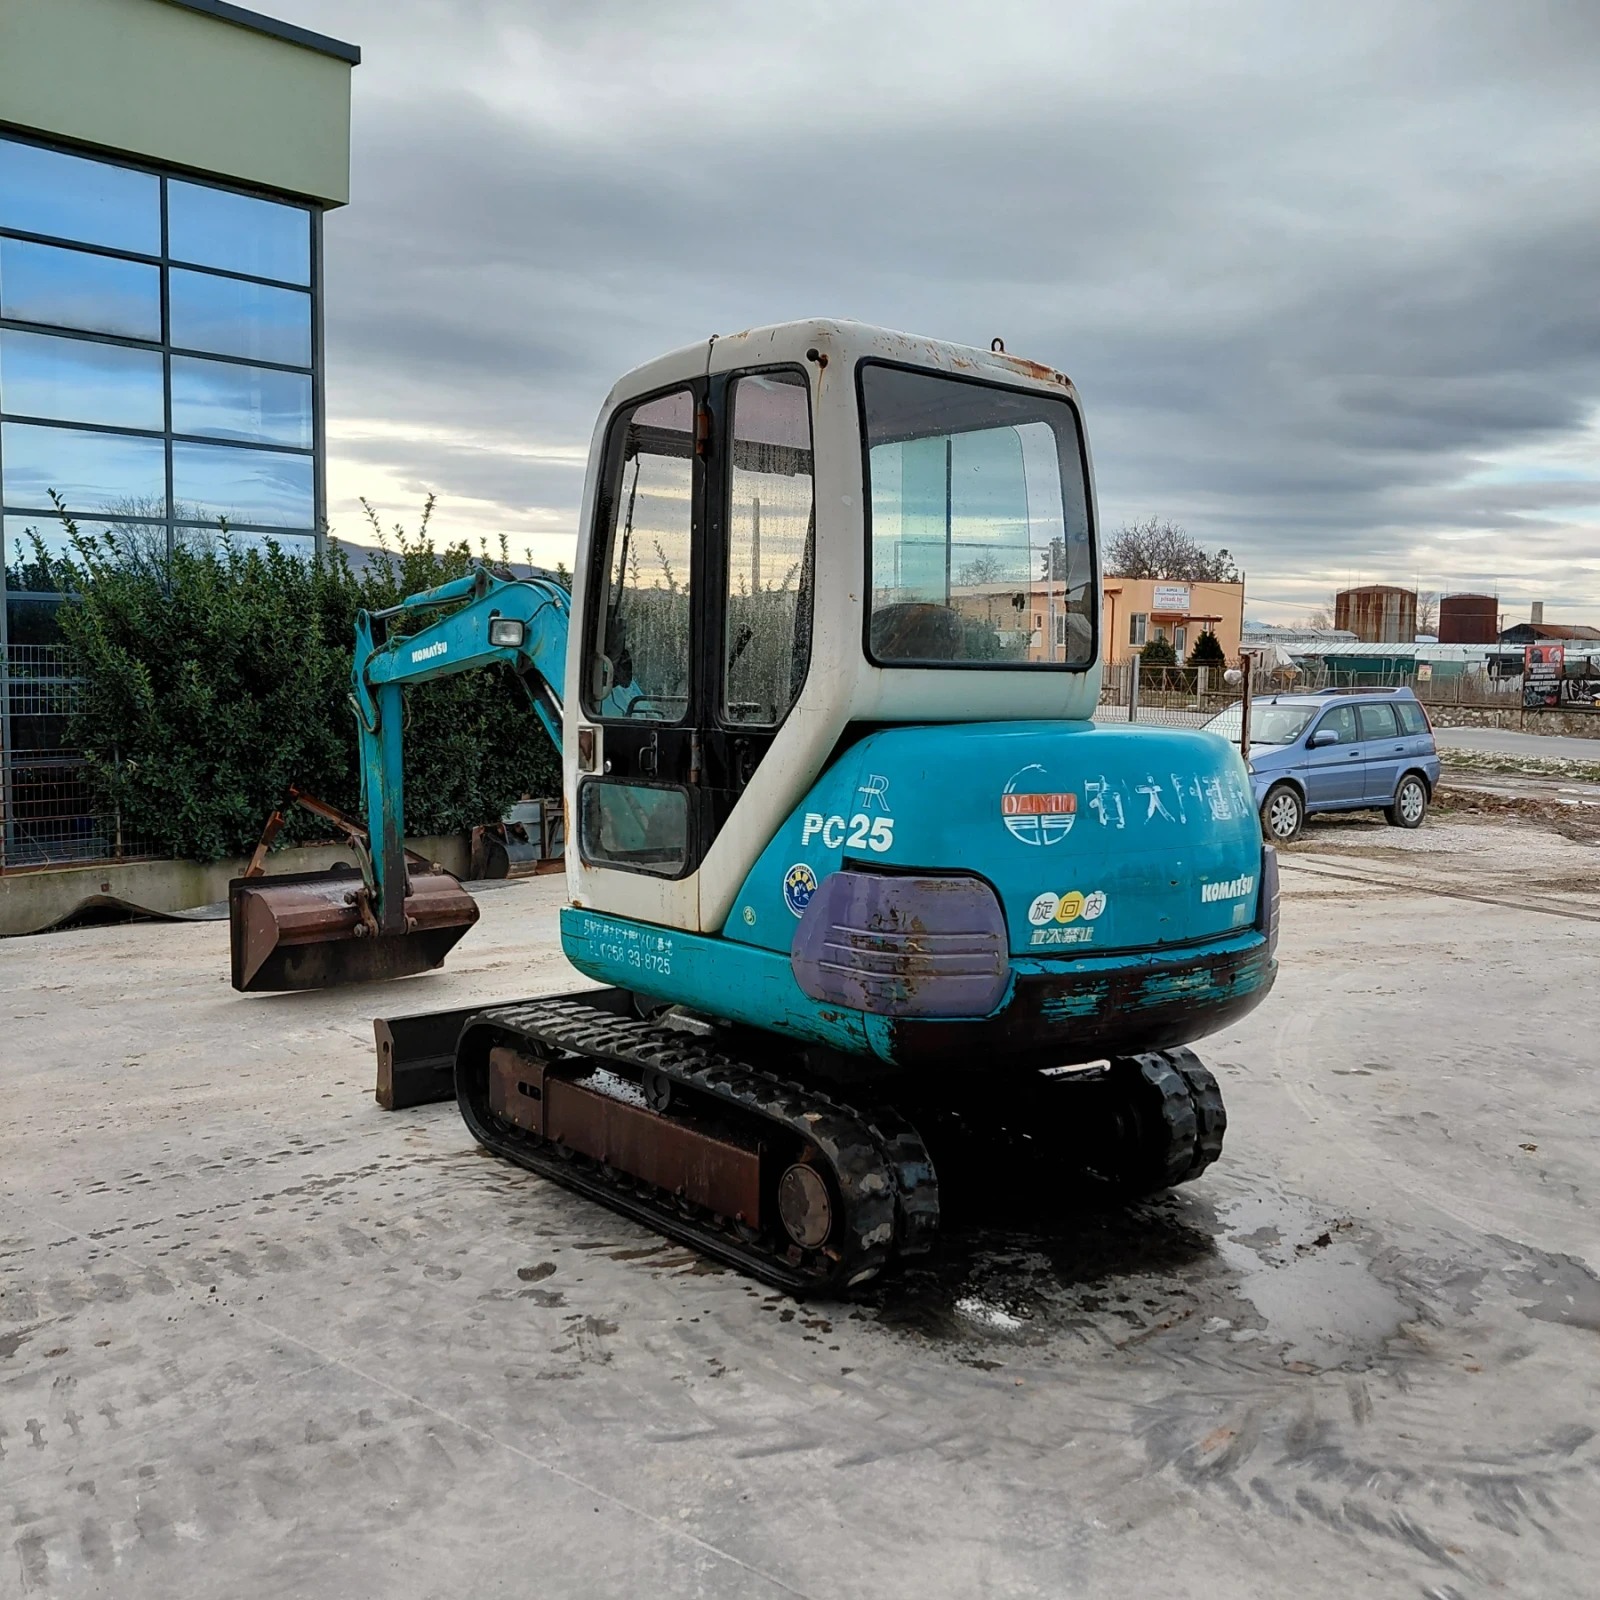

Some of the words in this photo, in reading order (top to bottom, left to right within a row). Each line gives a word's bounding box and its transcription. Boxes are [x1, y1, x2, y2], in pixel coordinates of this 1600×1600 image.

[411, 641, 448, 663] KOMATSU
[862, 774, 891, 812] R
[801, 812, 895, 852] PC25
[1201, 873, 1254, 903] KOMATSU
